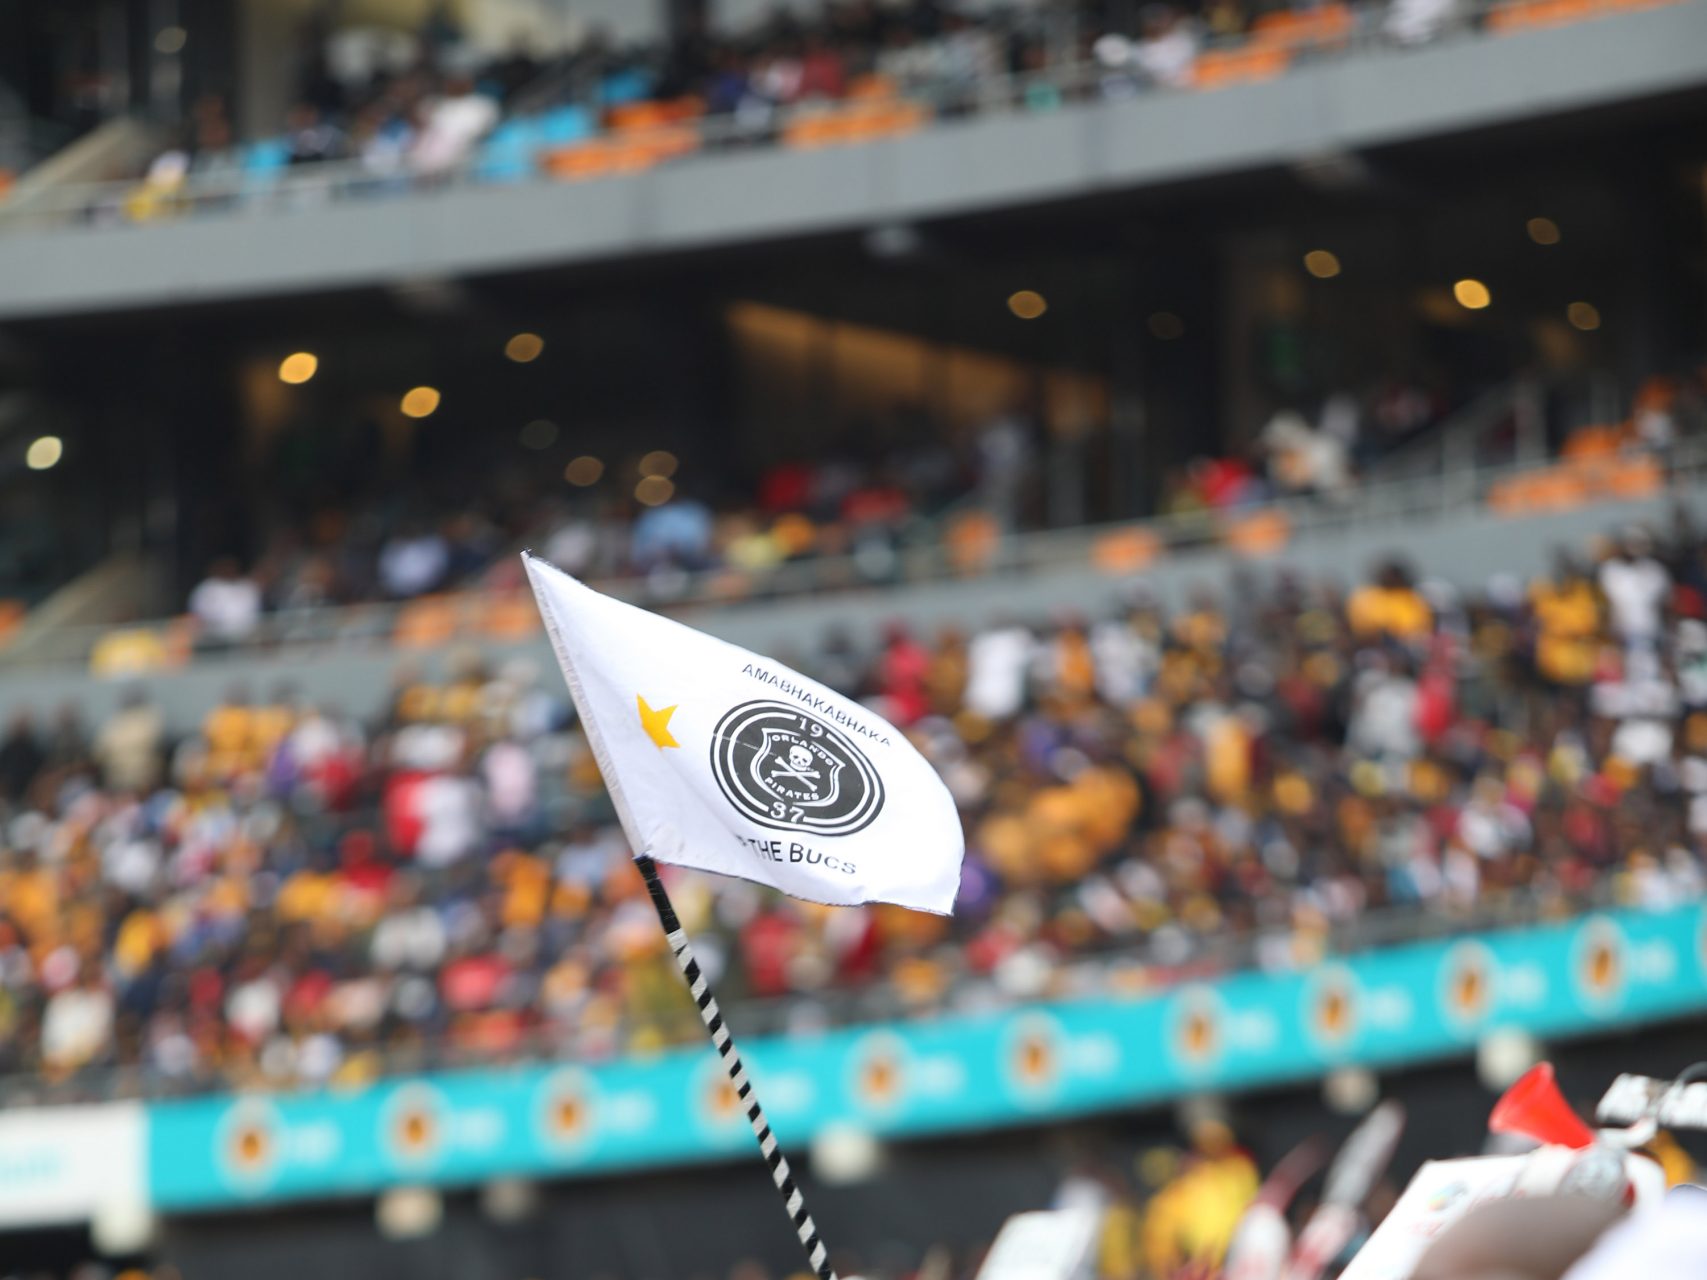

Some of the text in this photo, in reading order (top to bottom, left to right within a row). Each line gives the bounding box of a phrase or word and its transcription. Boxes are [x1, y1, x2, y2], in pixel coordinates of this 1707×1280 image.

[742, 663, 891, 747] AMABHAKABHAKA
[797, 716, 824, 738] 19
[771, 734, 834, 766] ORLANDO
[764, 776, 820, 801] PIRATES
[770, 801, 805, 823] 37
[789, 842, 857, 875] BUCS
